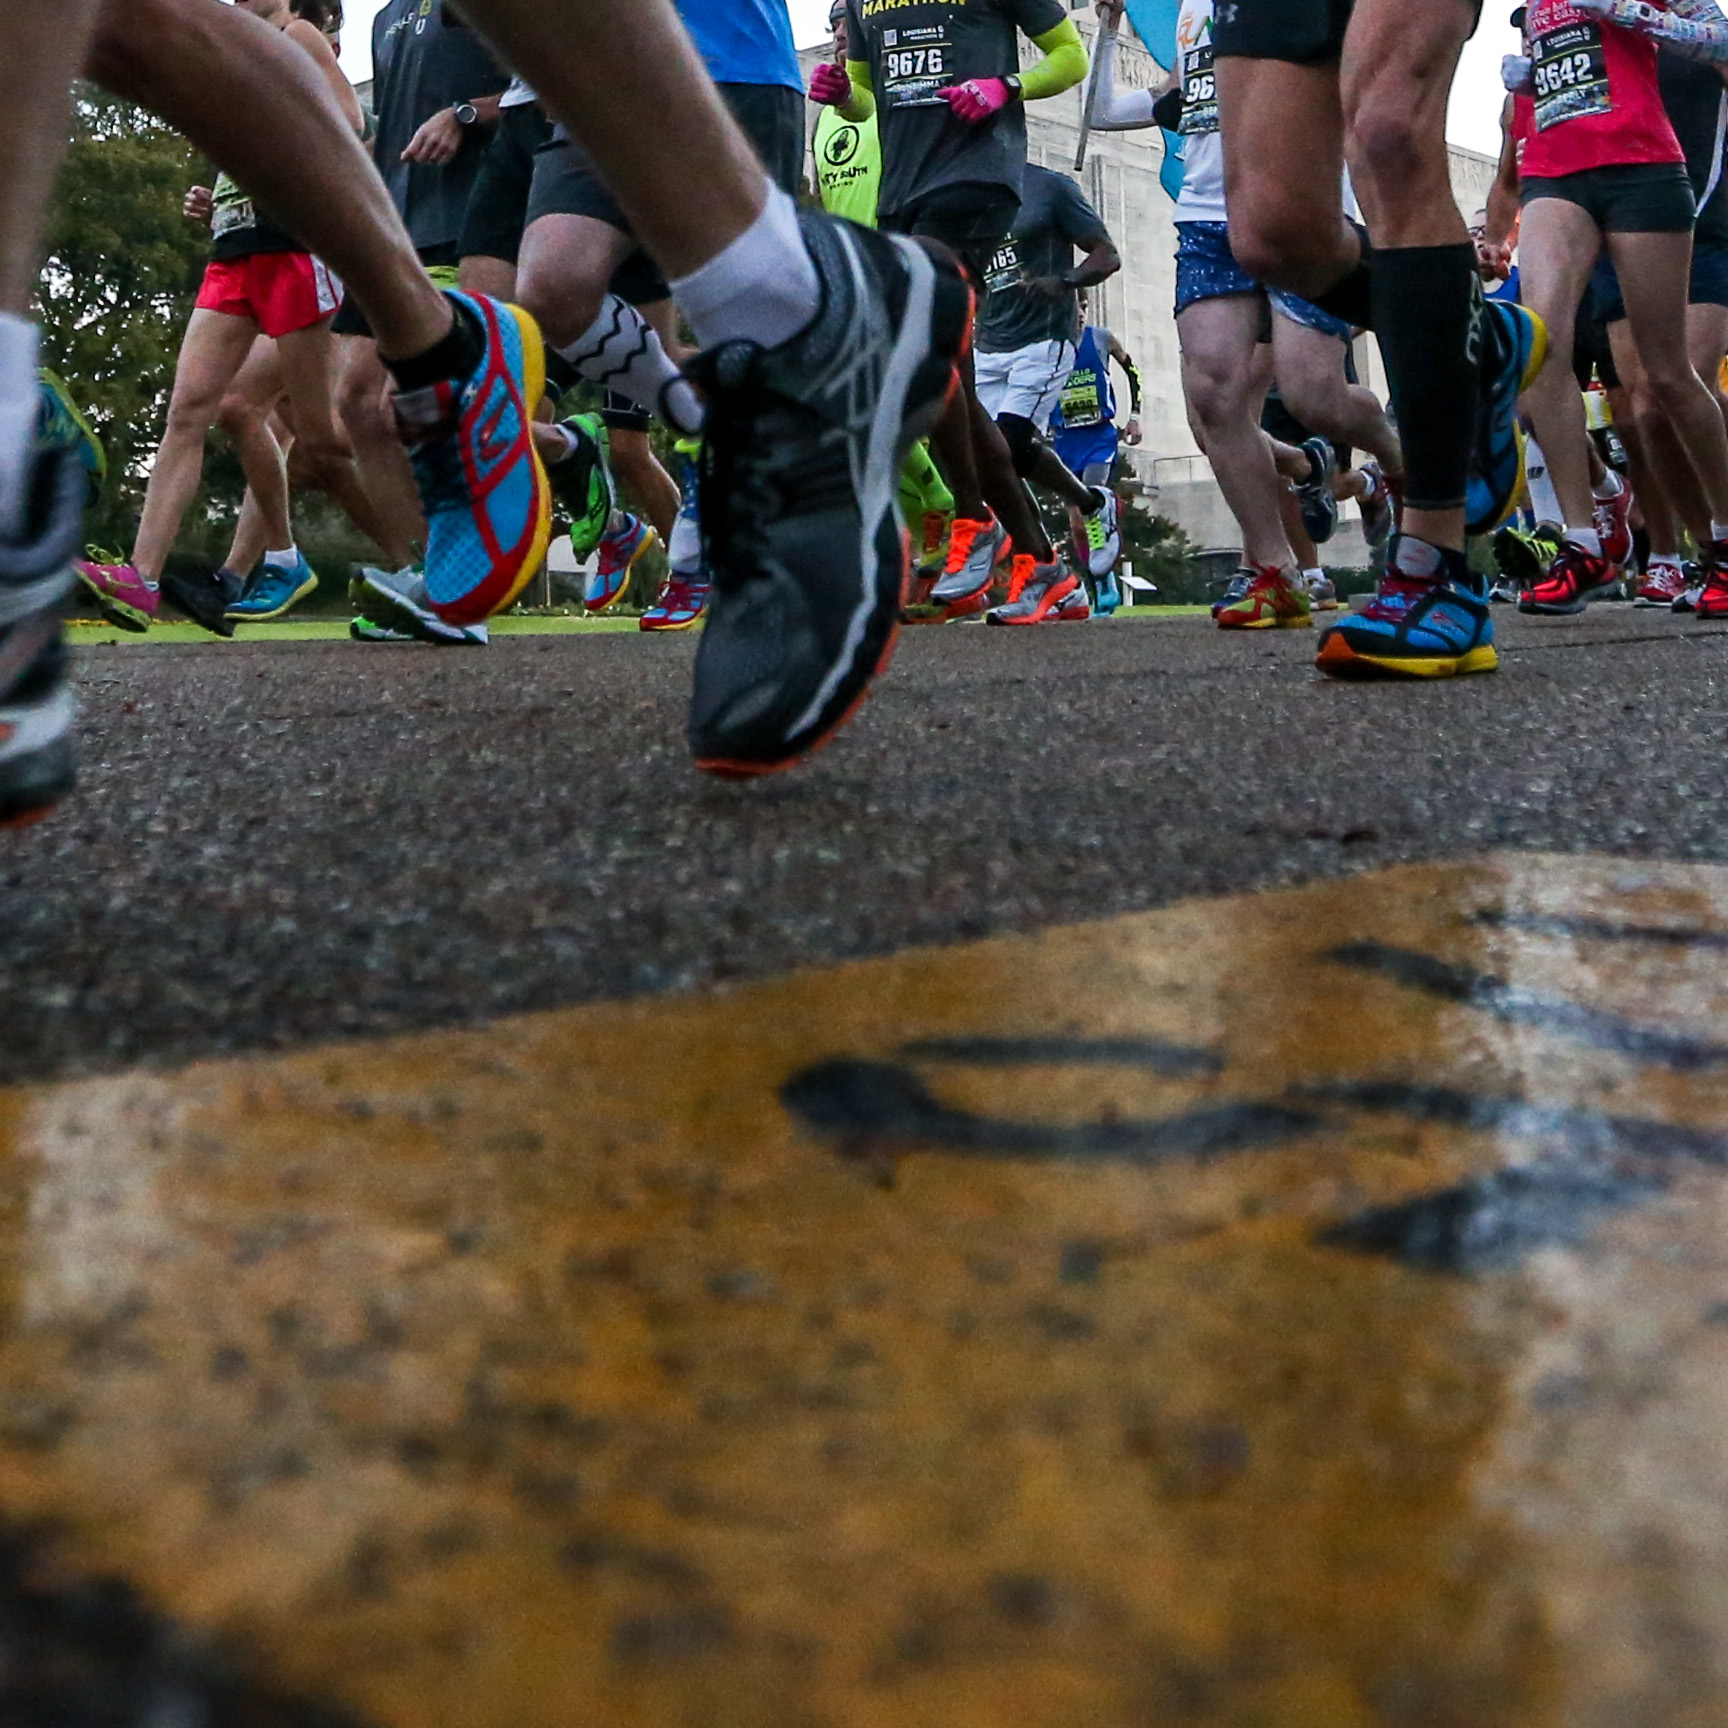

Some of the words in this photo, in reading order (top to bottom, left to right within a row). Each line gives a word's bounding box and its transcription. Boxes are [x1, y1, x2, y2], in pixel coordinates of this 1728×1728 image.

[887, 48, 943, 78] 9676
[1534, 53, 1593, 96] 9642
[1186, 75, 1214, 102] 96
